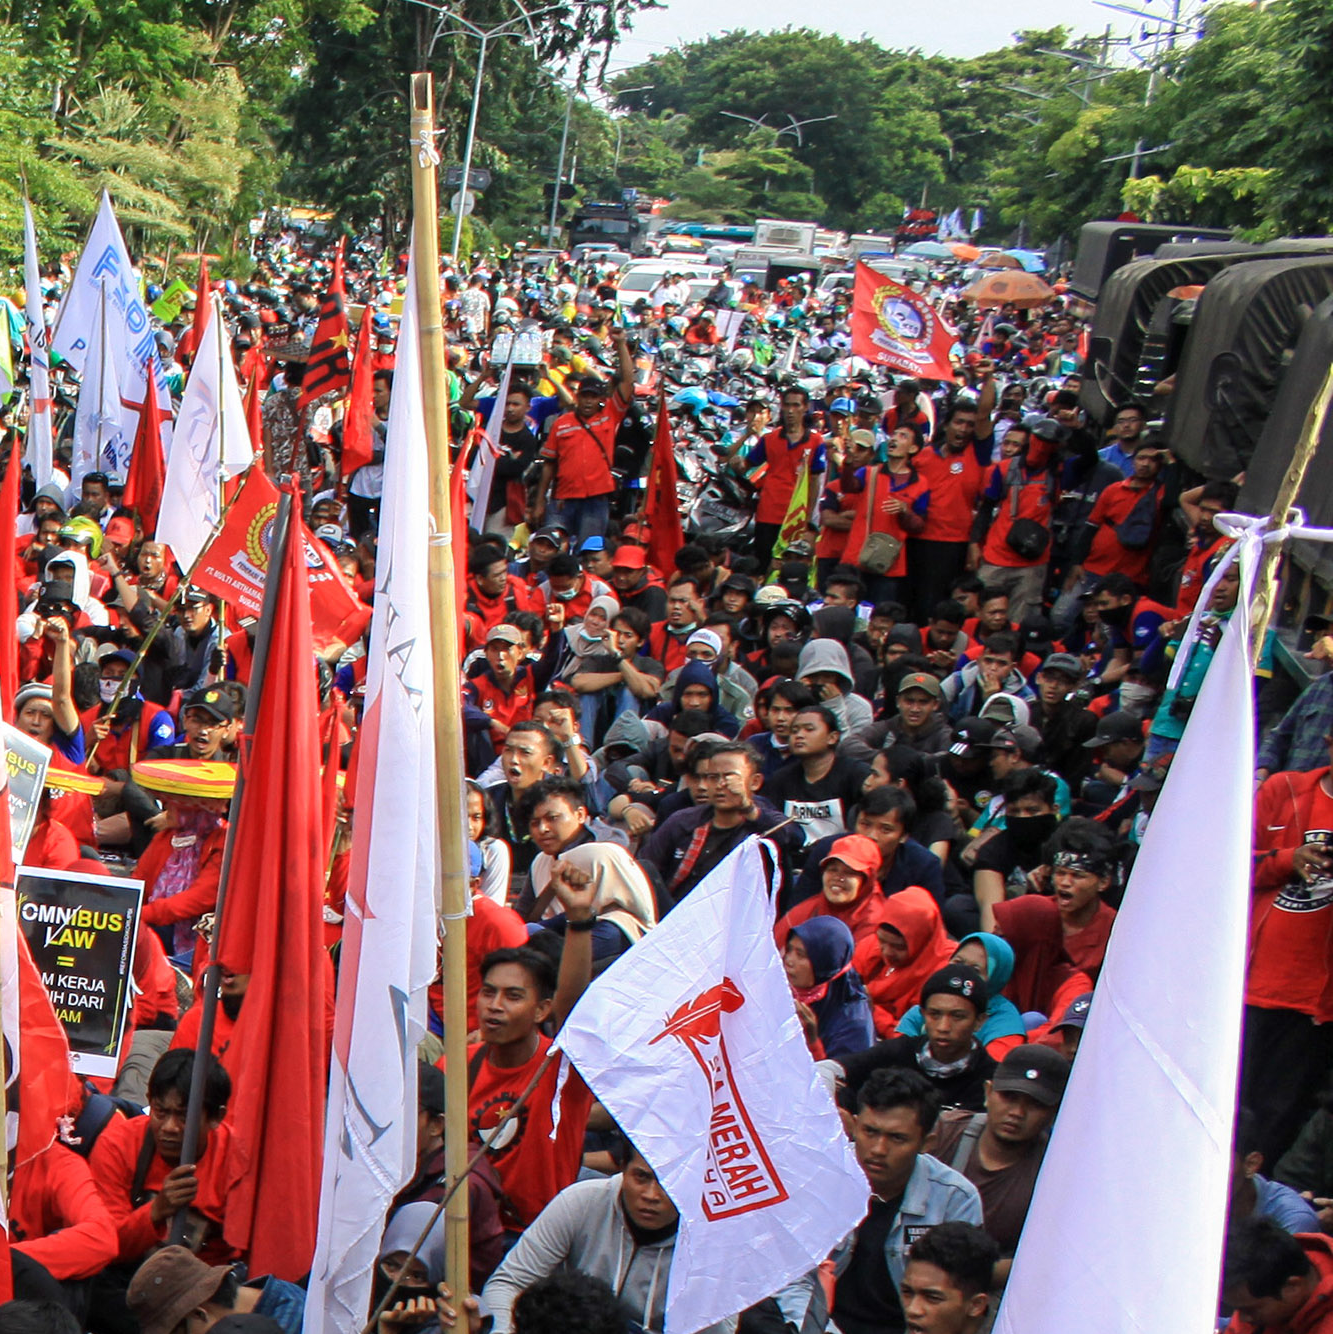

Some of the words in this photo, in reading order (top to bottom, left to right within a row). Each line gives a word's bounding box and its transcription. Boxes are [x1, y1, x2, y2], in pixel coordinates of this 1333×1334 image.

[22, 903, 123, 932] OMNIBUS
[45, 926, 96, 949] LAW
[57, 974, 106, 993] KERJA
[70, 995, 103, 1010] DARI
[710, 1102, 769, 1200] MERAH
